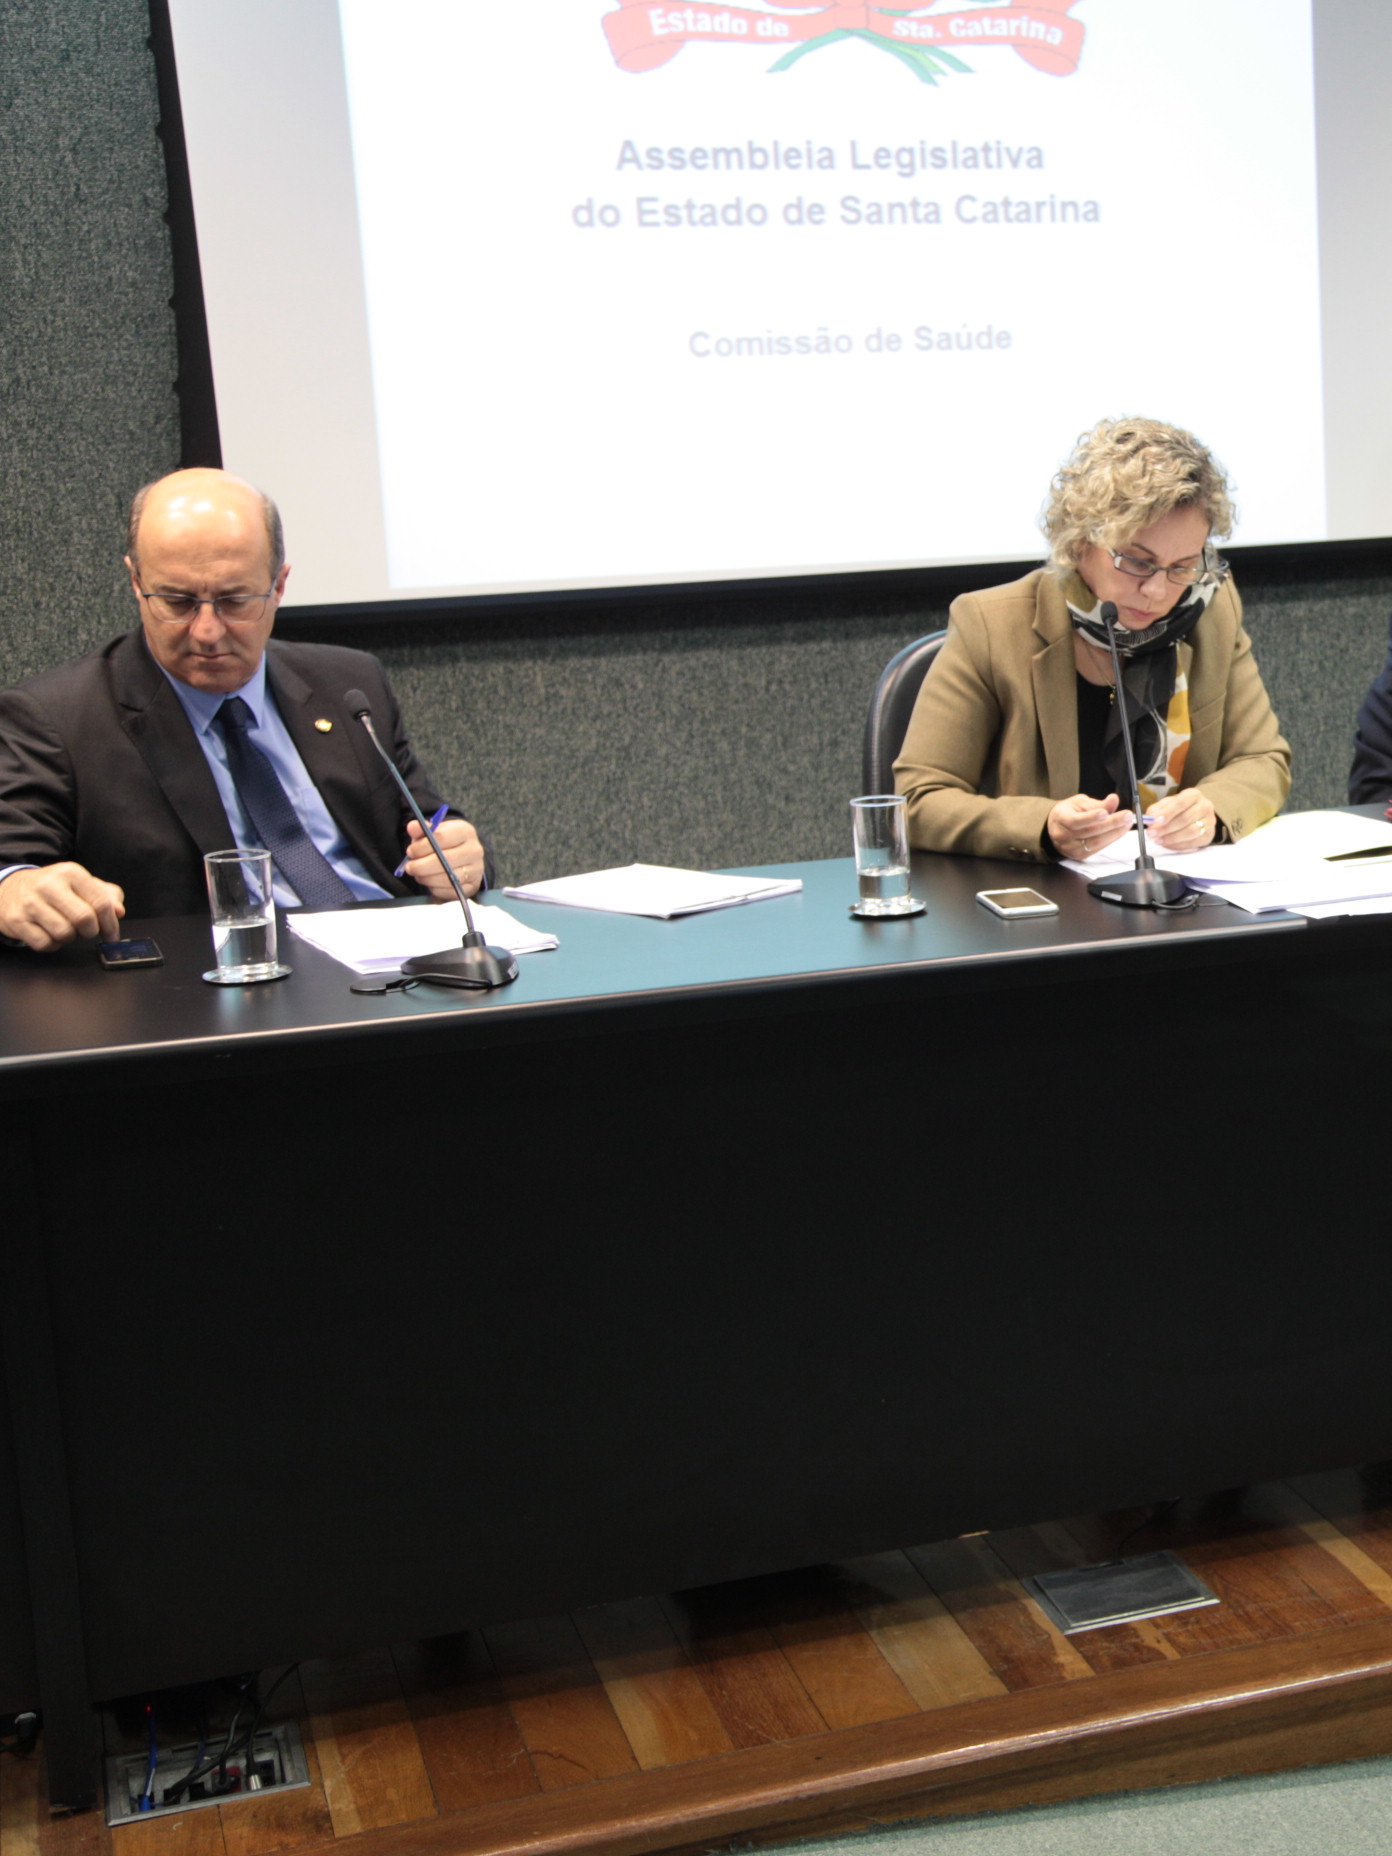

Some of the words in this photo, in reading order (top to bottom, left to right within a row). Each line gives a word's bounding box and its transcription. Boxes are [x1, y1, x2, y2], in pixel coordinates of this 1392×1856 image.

[649, 9, 748, 36] Estado
[756, 17, 790, 37] de
[892, 17, 943, 39] Sta.
[949, 15, 1064, 46] Catarina
[617, 140, 836, 171] Assembleia
[850, 140, 1044, 179] Legislativa
[571, 197, 622, 229] do
[636, 196, 769, 228] Estado
[782, 195, 827, 226] de
[840, 194, 943, 226] Santa
[954, 193, 1101, 224] Catarina
[689, 326, 854, 358] Comissão
[864, 327, 903, 353] de
[914, 323, 1013, 352] Saúde
